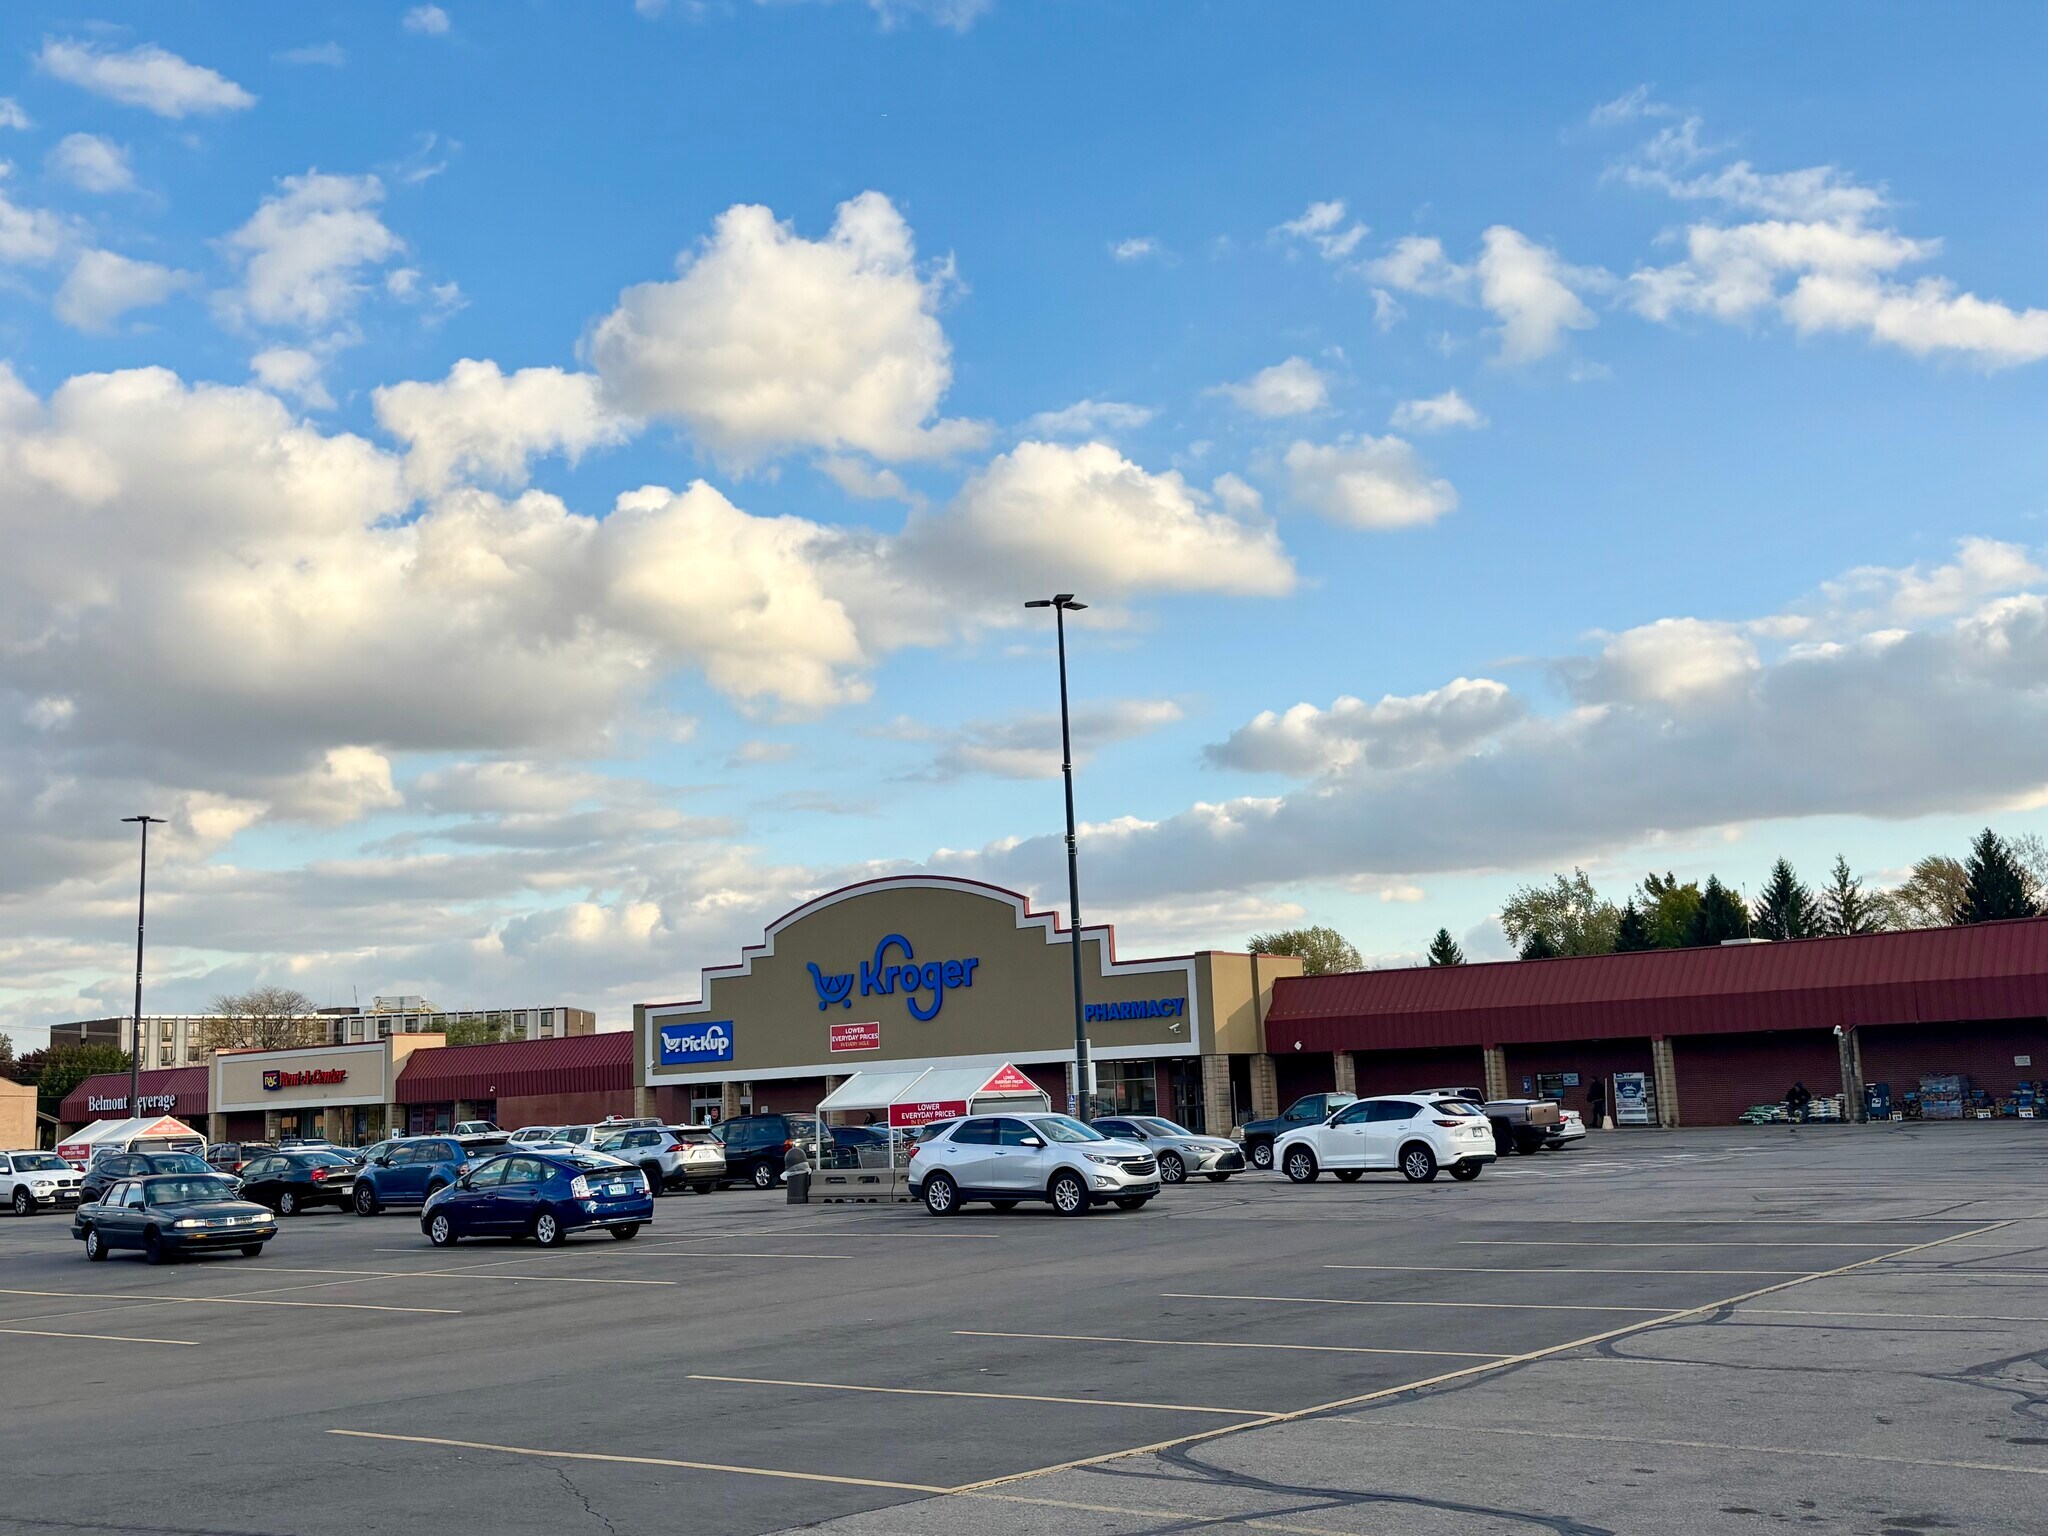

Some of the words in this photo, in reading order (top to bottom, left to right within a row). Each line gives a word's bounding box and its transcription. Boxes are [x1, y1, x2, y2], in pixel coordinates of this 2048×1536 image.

[860, 934, 978, 1021] Kroger
[1084, 997, 1185, 1022] PHARMACY
[832, 1034, 859, 1042] EVERYDAY
[264, 1076, 278, 1087] RAC
[88, 1095, 128, 1112] Belmont
[136, 1094, 176, 1112] everage
[917, 1103, 940, 1111] LOWER
[901, 1111, 934, 1120] EVERYDAY
[934, 1110, 956, 1118] PRICES
